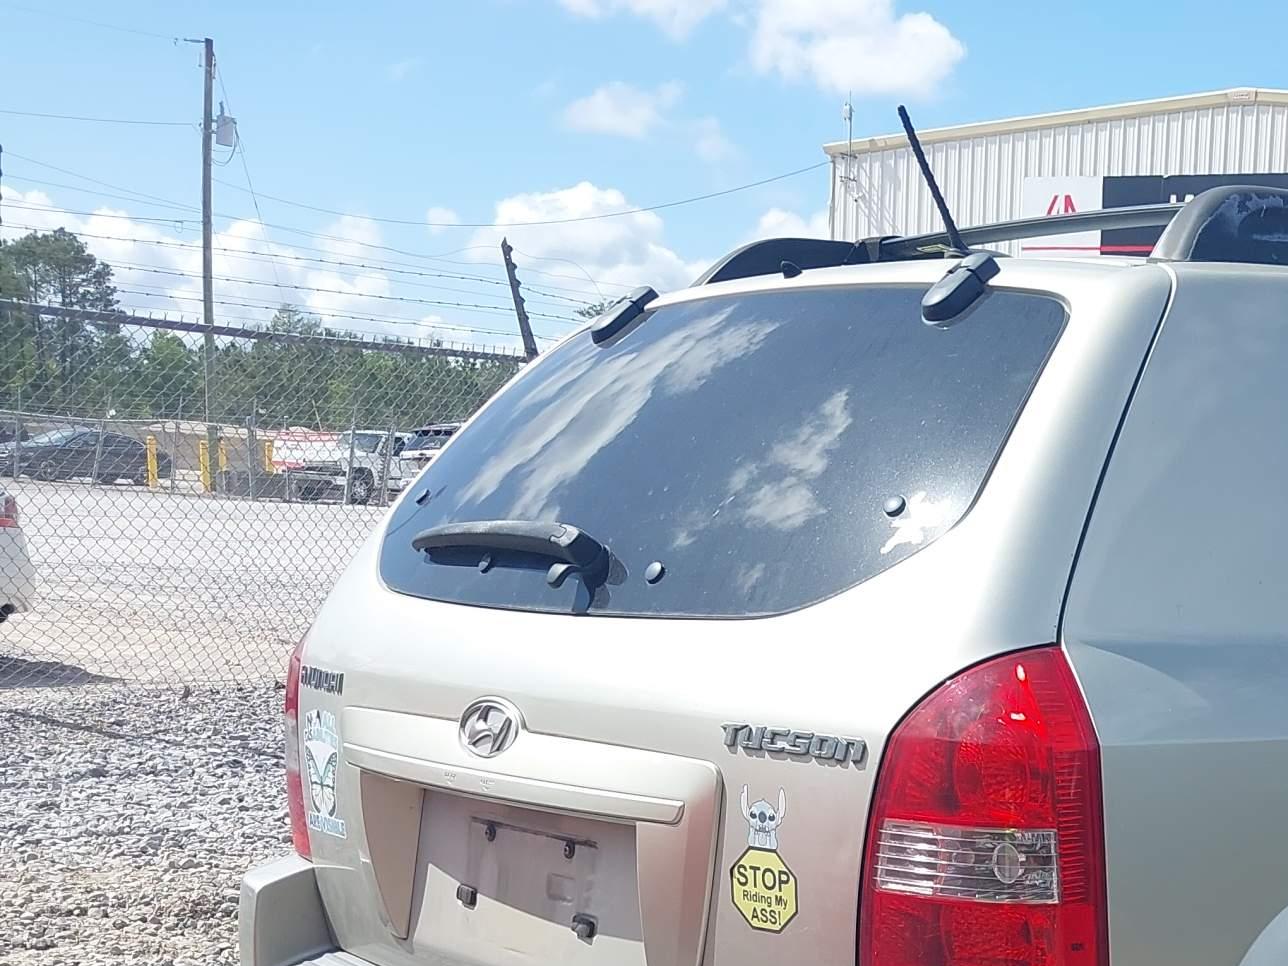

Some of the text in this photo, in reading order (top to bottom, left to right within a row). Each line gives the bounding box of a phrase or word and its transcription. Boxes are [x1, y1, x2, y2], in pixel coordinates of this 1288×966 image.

[736, 864, 790, 893] STOP
[742, 889, 788, 910] Riding My
[750, 906, 782, 926] ASS!
